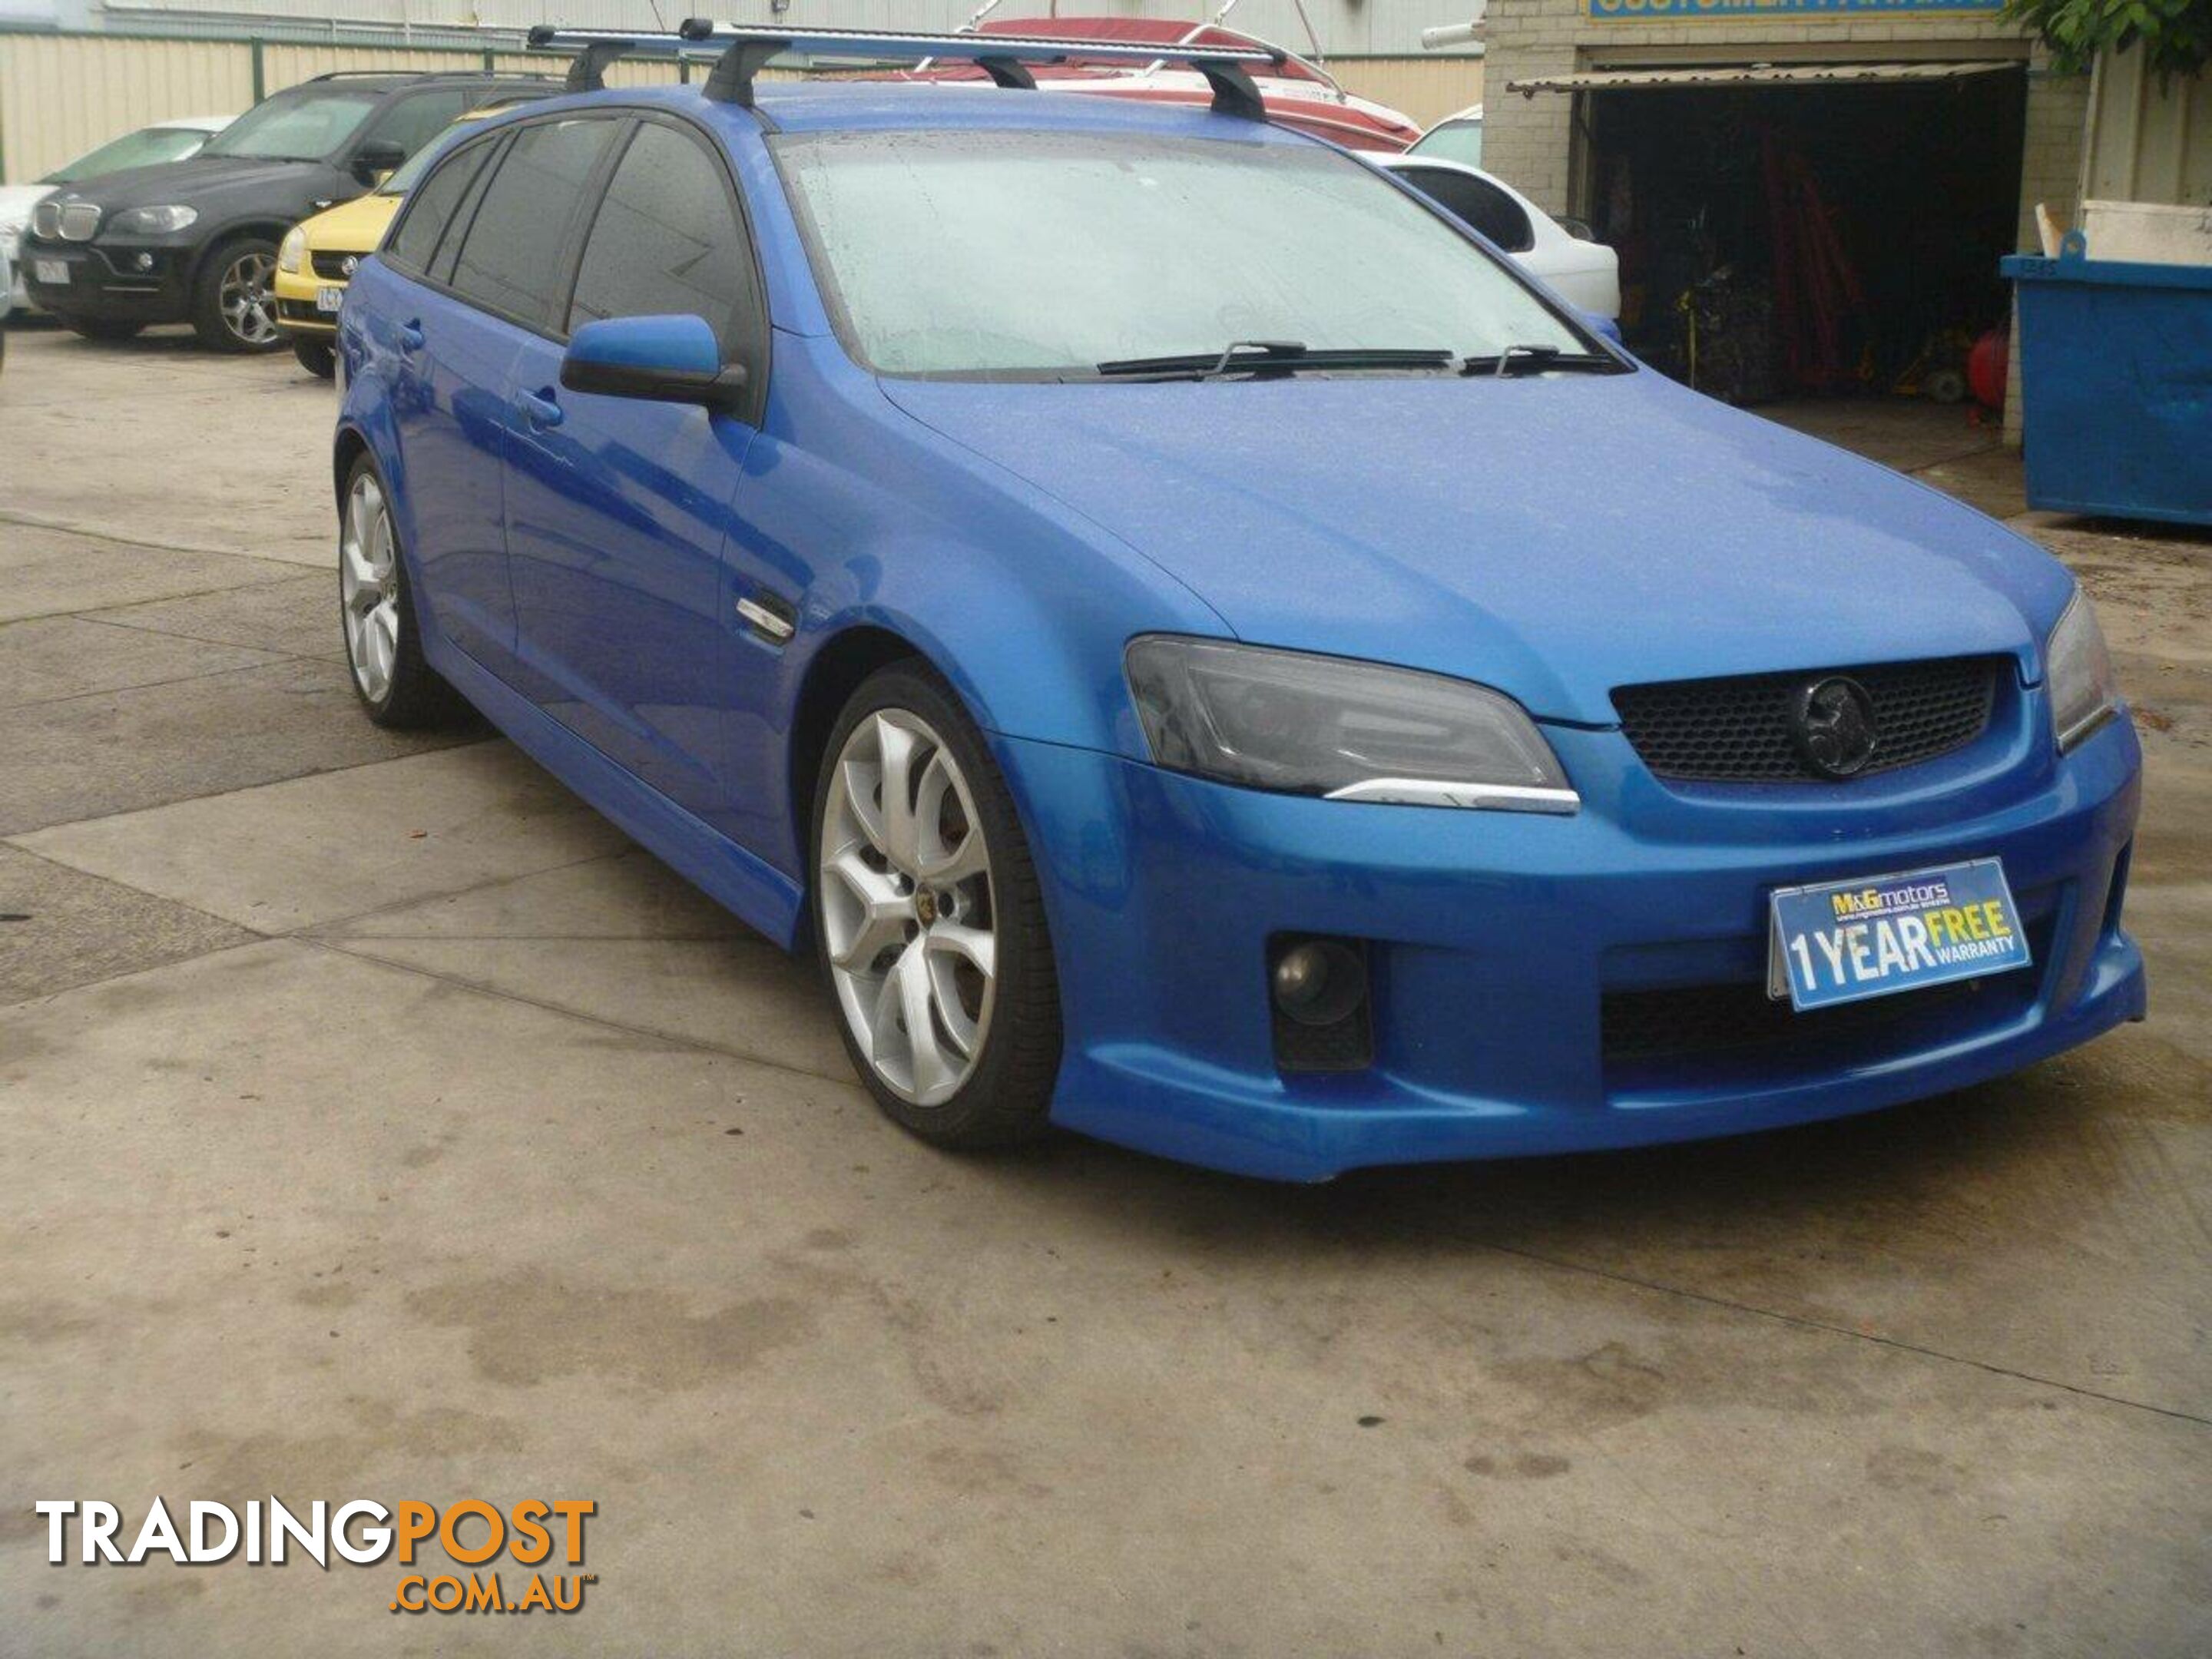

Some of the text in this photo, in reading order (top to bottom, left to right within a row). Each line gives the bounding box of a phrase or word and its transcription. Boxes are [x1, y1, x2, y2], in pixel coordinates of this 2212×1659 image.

[1790, 901, 2011, 991] 1 YEAR FREE
[1936, 936, 2015, 965] WARRANTY
